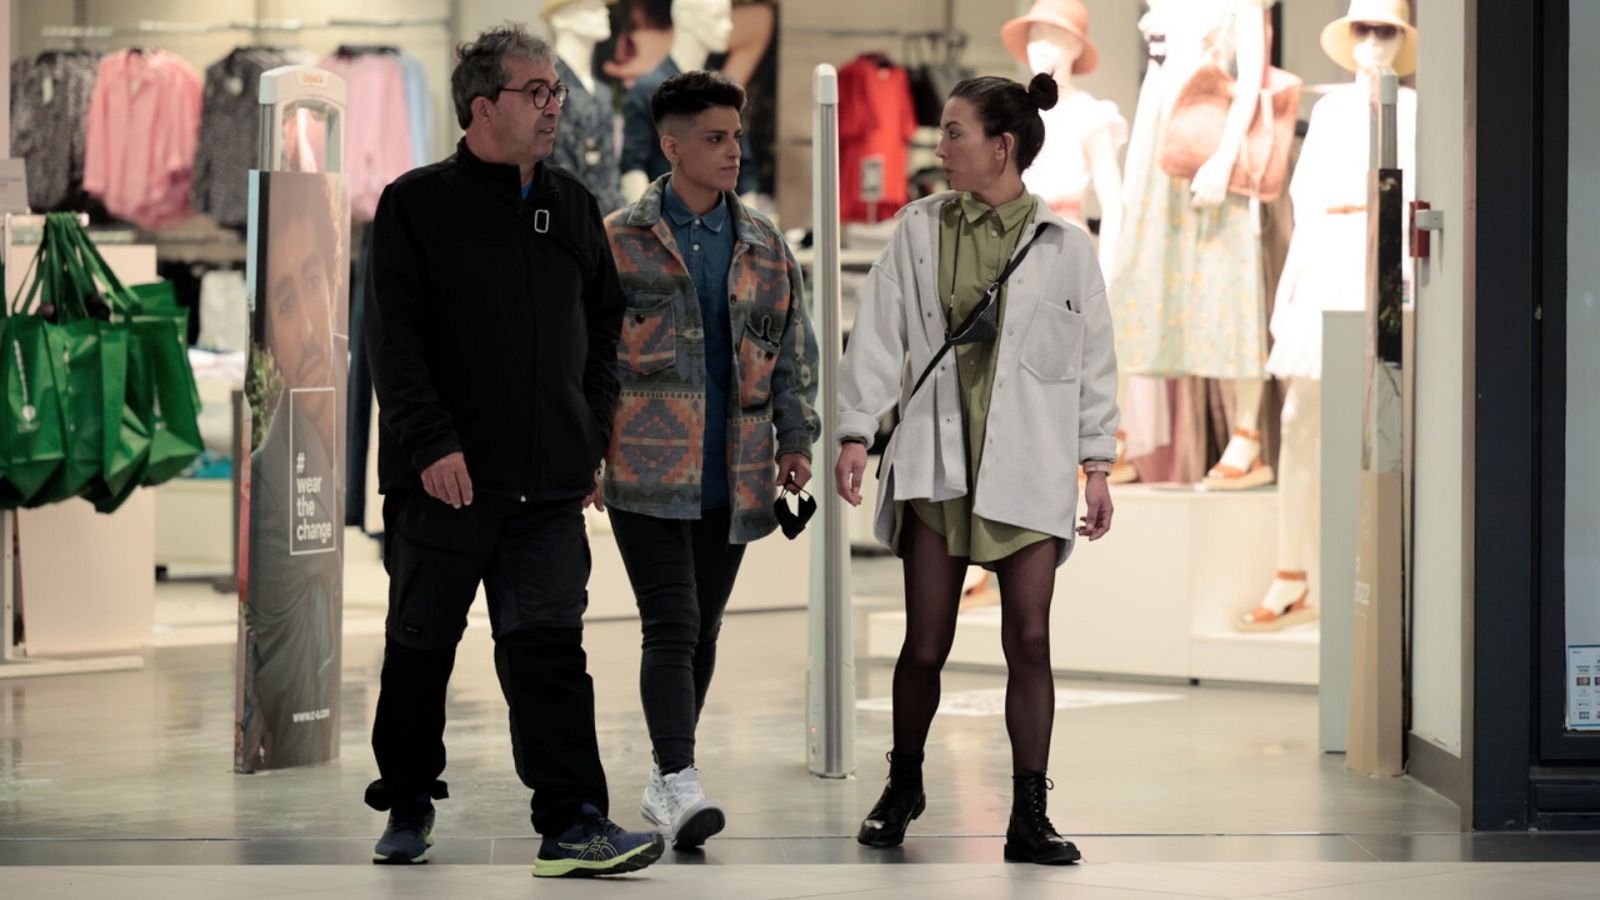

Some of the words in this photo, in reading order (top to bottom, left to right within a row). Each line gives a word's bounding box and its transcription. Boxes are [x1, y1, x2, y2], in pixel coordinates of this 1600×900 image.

[296, 452, 305, 474] #
[296, 476, 322, 494] wear
[296, 495, 315, 517] the
[296, 518, 332, 544] change
